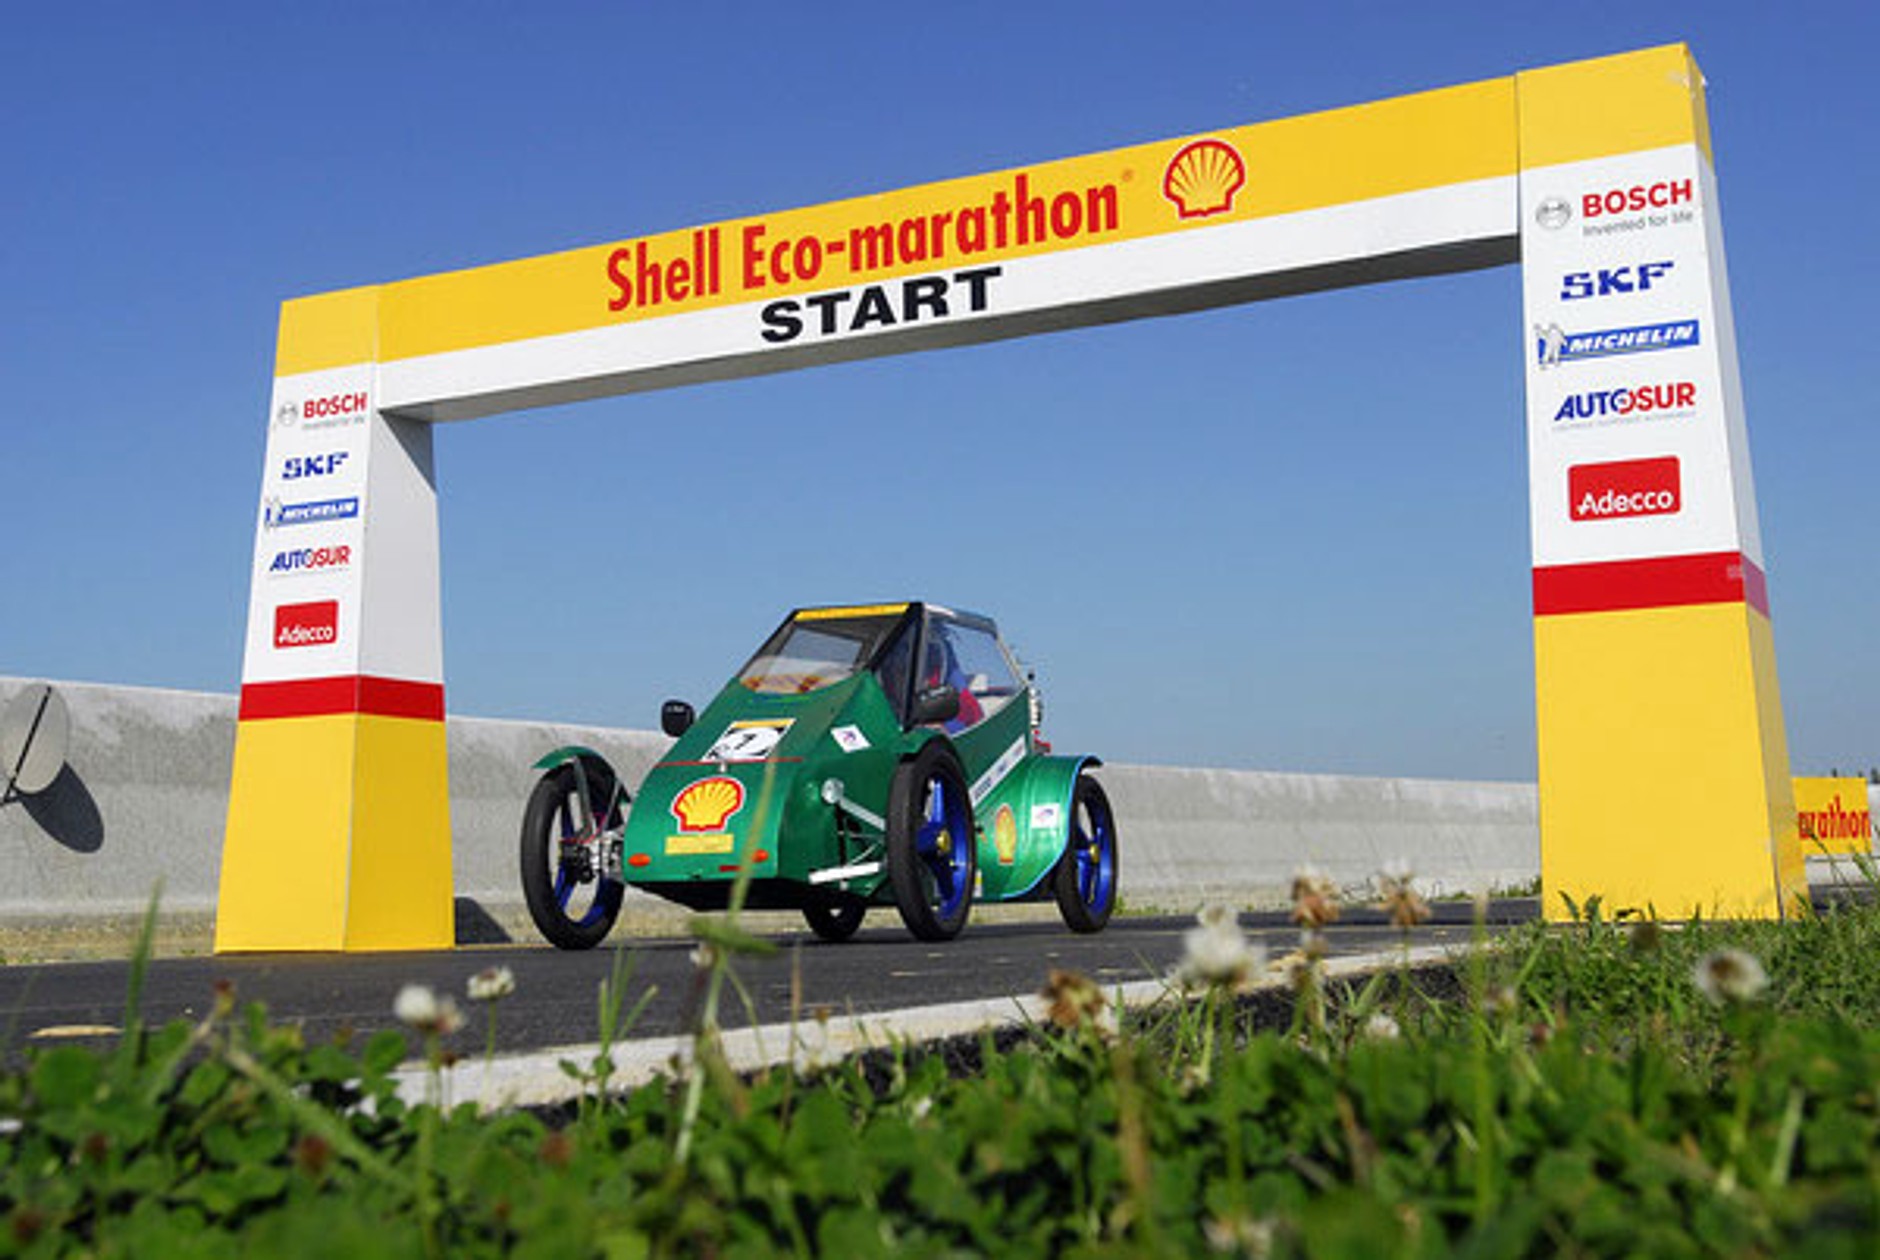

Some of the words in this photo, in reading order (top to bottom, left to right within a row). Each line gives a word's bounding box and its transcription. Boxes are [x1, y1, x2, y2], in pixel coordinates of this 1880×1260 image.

[1582, 178, 1693, 218] BOSCH
[607, 226, 720, 312] Shell
[742, 172, 1120, 290] Eco-marathon
[1560, 260, 1675, 301] SKF
[760, 265, 1003, 343] START
[1570, 325, 1694, 352] MICHELIN
[303, 391, 369, 419] BOSCH
[1553, 382, 1698, 422] AUTOSUR
[281, 451, 349, 480] SKF
[1576, 488, 1675, 515] Adecco
[269, 545, 351, 572] AUTOSUR
[277, 622, 334, 645] Adecco
[1798, 794, 1872, 839] arathon
